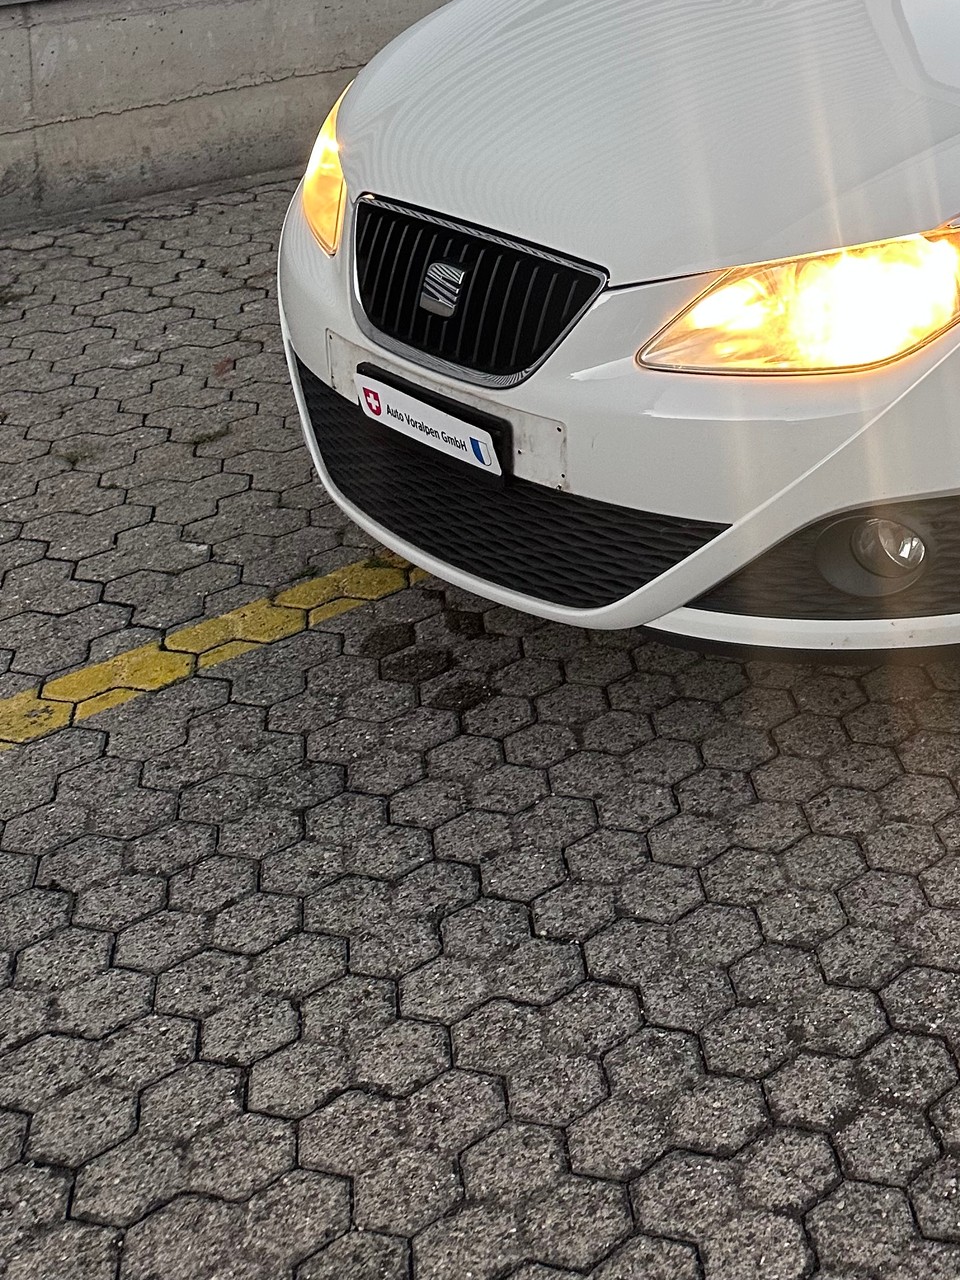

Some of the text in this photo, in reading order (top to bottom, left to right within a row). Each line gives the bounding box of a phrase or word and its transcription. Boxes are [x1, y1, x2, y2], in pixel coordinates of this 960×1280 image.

[386, 404, 468, 452] Auto Voralpen GmbH
